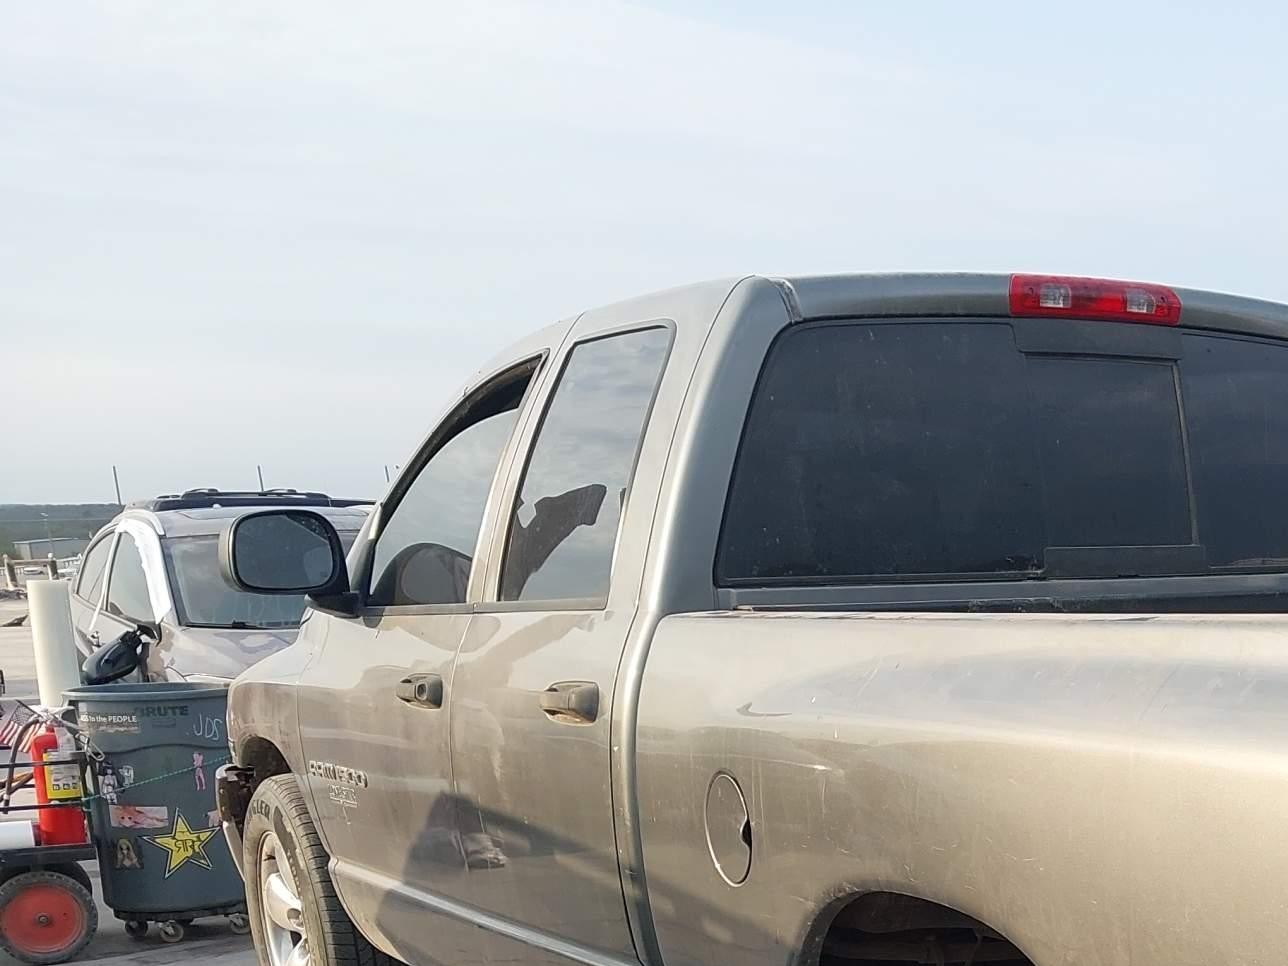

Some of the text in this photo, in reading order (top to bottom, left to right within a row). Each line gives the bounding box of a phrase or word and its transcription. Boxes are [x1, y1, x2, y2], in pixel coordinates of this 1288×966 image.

[135, 705, 189, 717] BRUTE
[96, 714, 107, 722] the
[108, 715, 137, 723] PEOPLE
